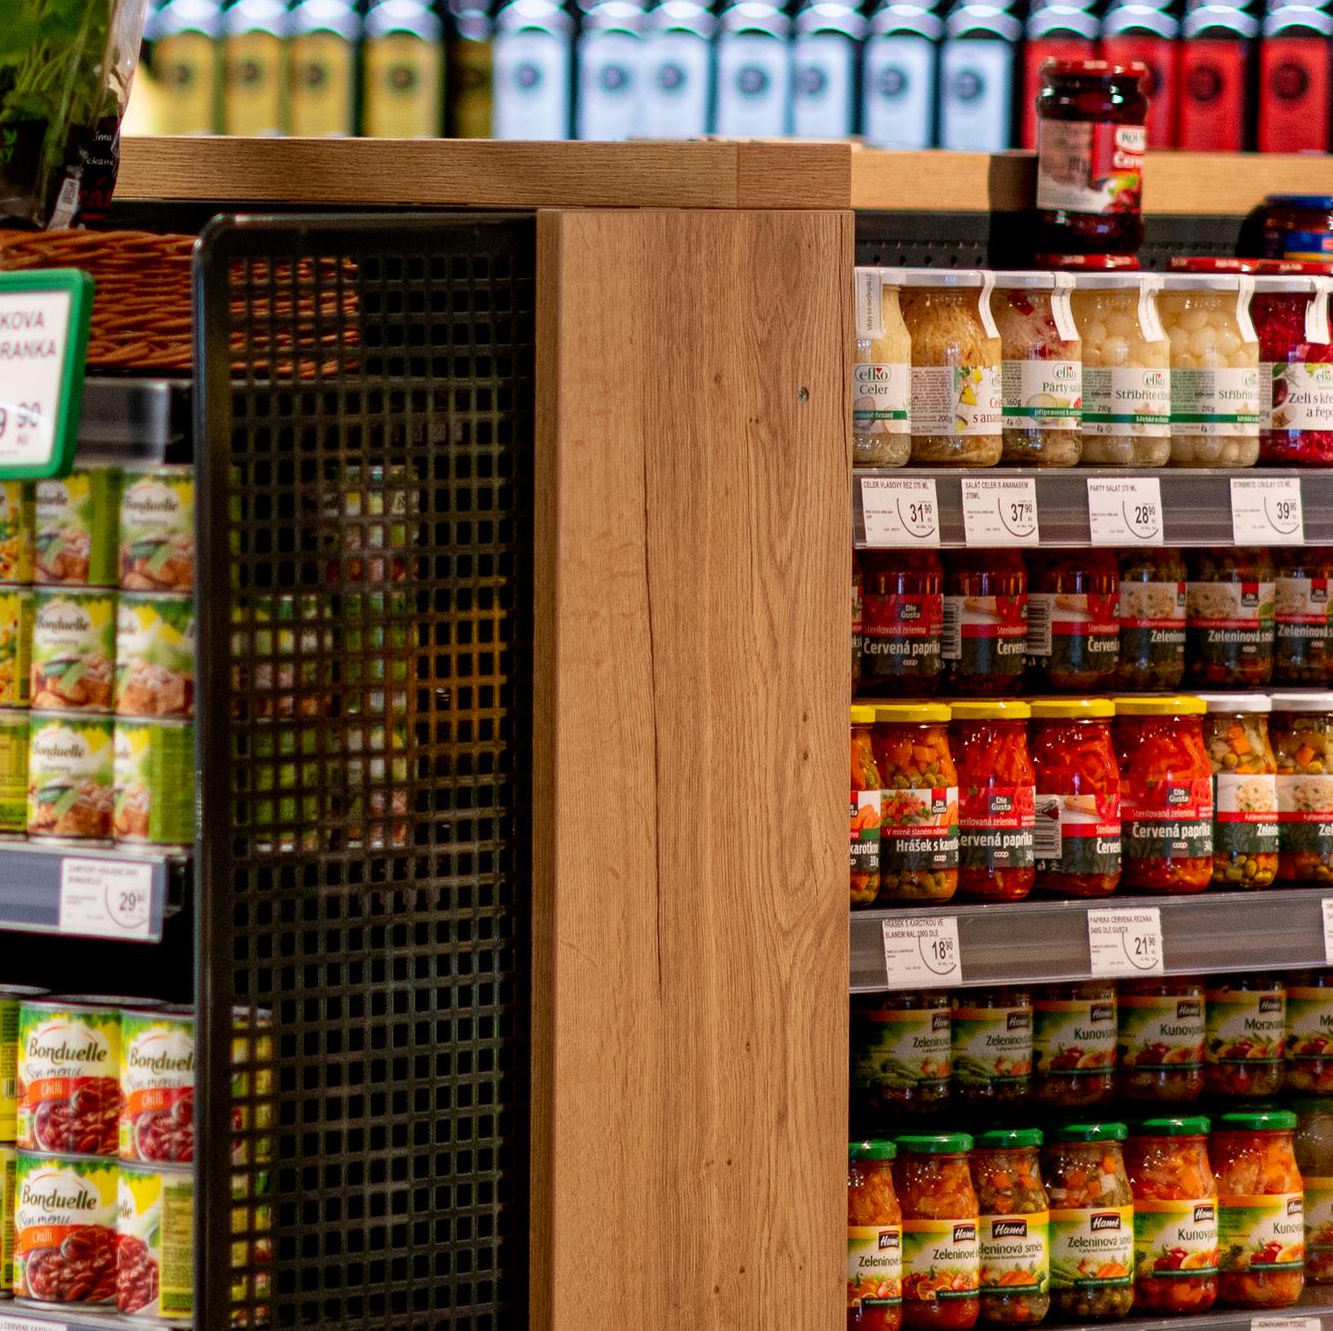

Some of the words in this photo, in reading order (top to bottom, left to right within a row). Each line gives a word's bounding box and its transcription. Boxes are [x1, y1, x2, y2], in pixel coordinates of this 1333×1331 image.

[859, 383, 889, 396] Celer
[1041, 381, 1069, 394] Párty
[1288, 391, 1312, 405] Zelí
[17, 401, 43, 429] 90
[909, 503, 925, 523] 31
[1010, 503, 1024, 523] 37
[1134, 505, 1149, 524] 28
[900, 610, 921, 620] Gusta
[863, 635, 910, 654] Červená
[995, 796, 1008, 804] Dle
[1168, 794, 1190, 803] Gusta
[1172, 788, 1186, 796] Dle
[990, 803, 1012, 812] Gusta
[1132, 822, 1180, 839] Červená
[896, 838, 932, 853] Hrášek
[931, 940, 946, 961] 18
[1134, 935, 1149, 956] 21
[28, 1037, 108, 1064] Bonduelle
[39, 1080, 64, 1096] Chilli
[21, 1185, 98, 1213] Bonduelle
